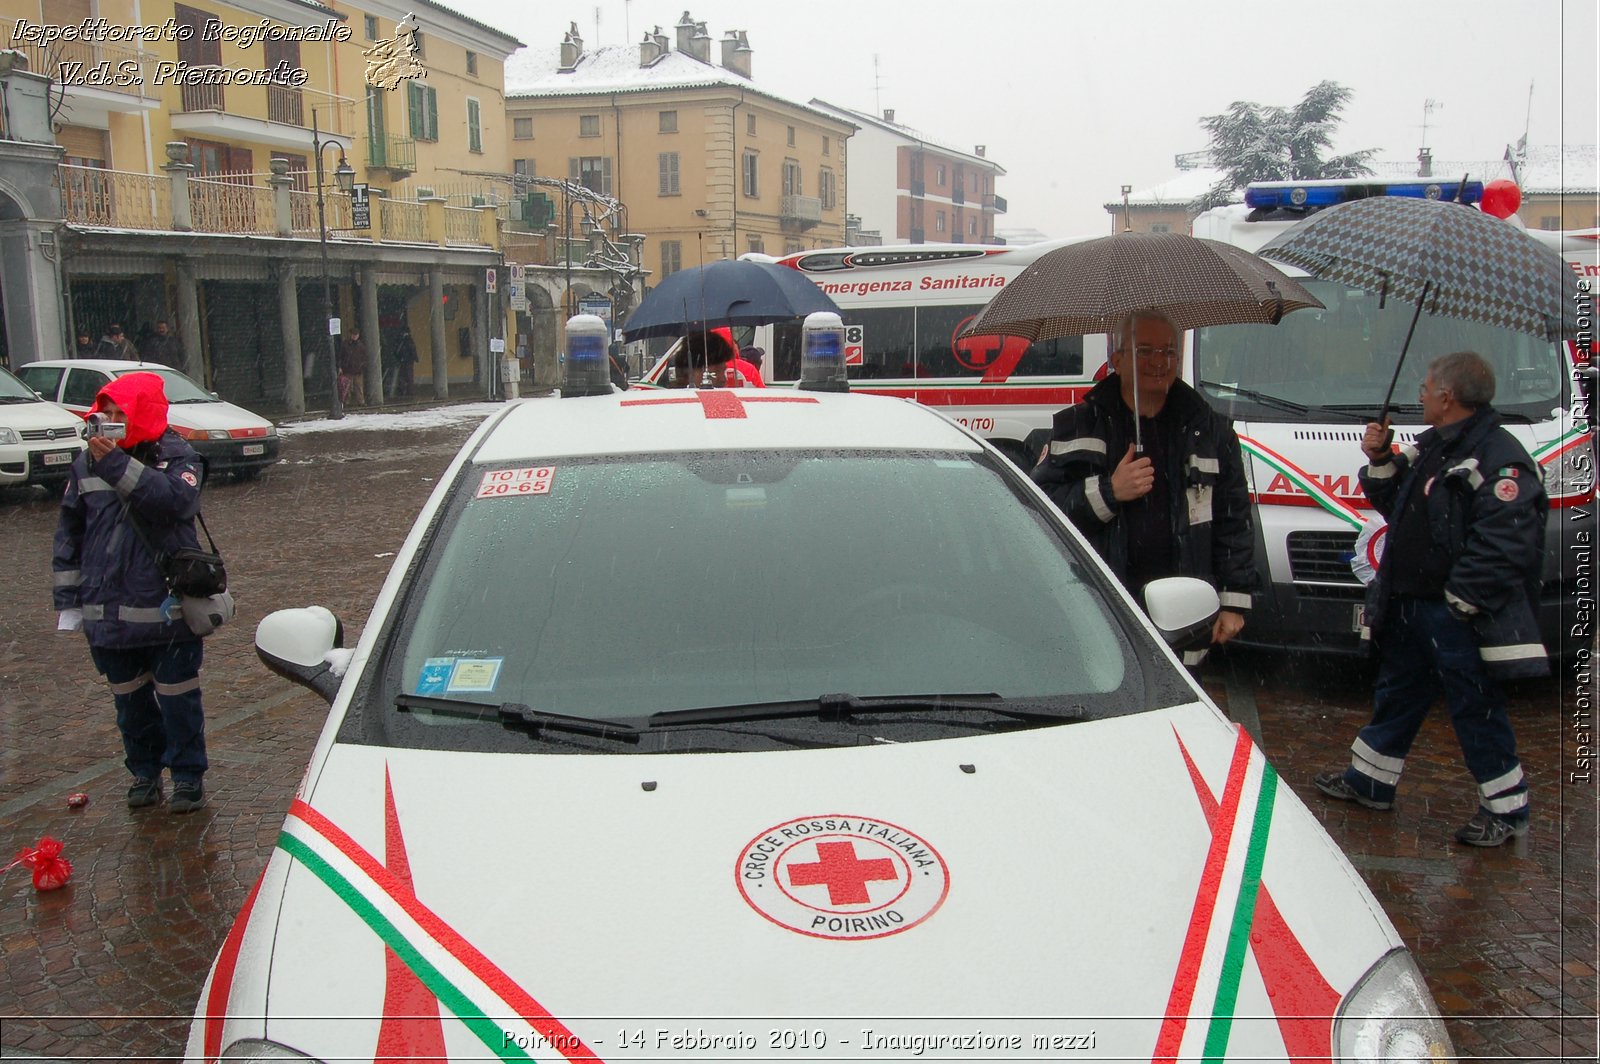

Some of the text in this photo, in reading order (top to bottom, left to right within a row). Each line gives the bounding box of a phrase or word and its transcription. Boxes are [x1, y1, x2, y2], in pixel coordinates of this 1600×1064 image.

[919, 274, 1006, 290] Sanitaria
[970, 417, 995, 432] (TO)
[491, 469, 550, 481] TO 10
[481, 481, 546, 496] 20-65
[744, 820, 935, 879] CROCE ROSSA ITALIANA
[811, 910, 904, 933] POIRINO
